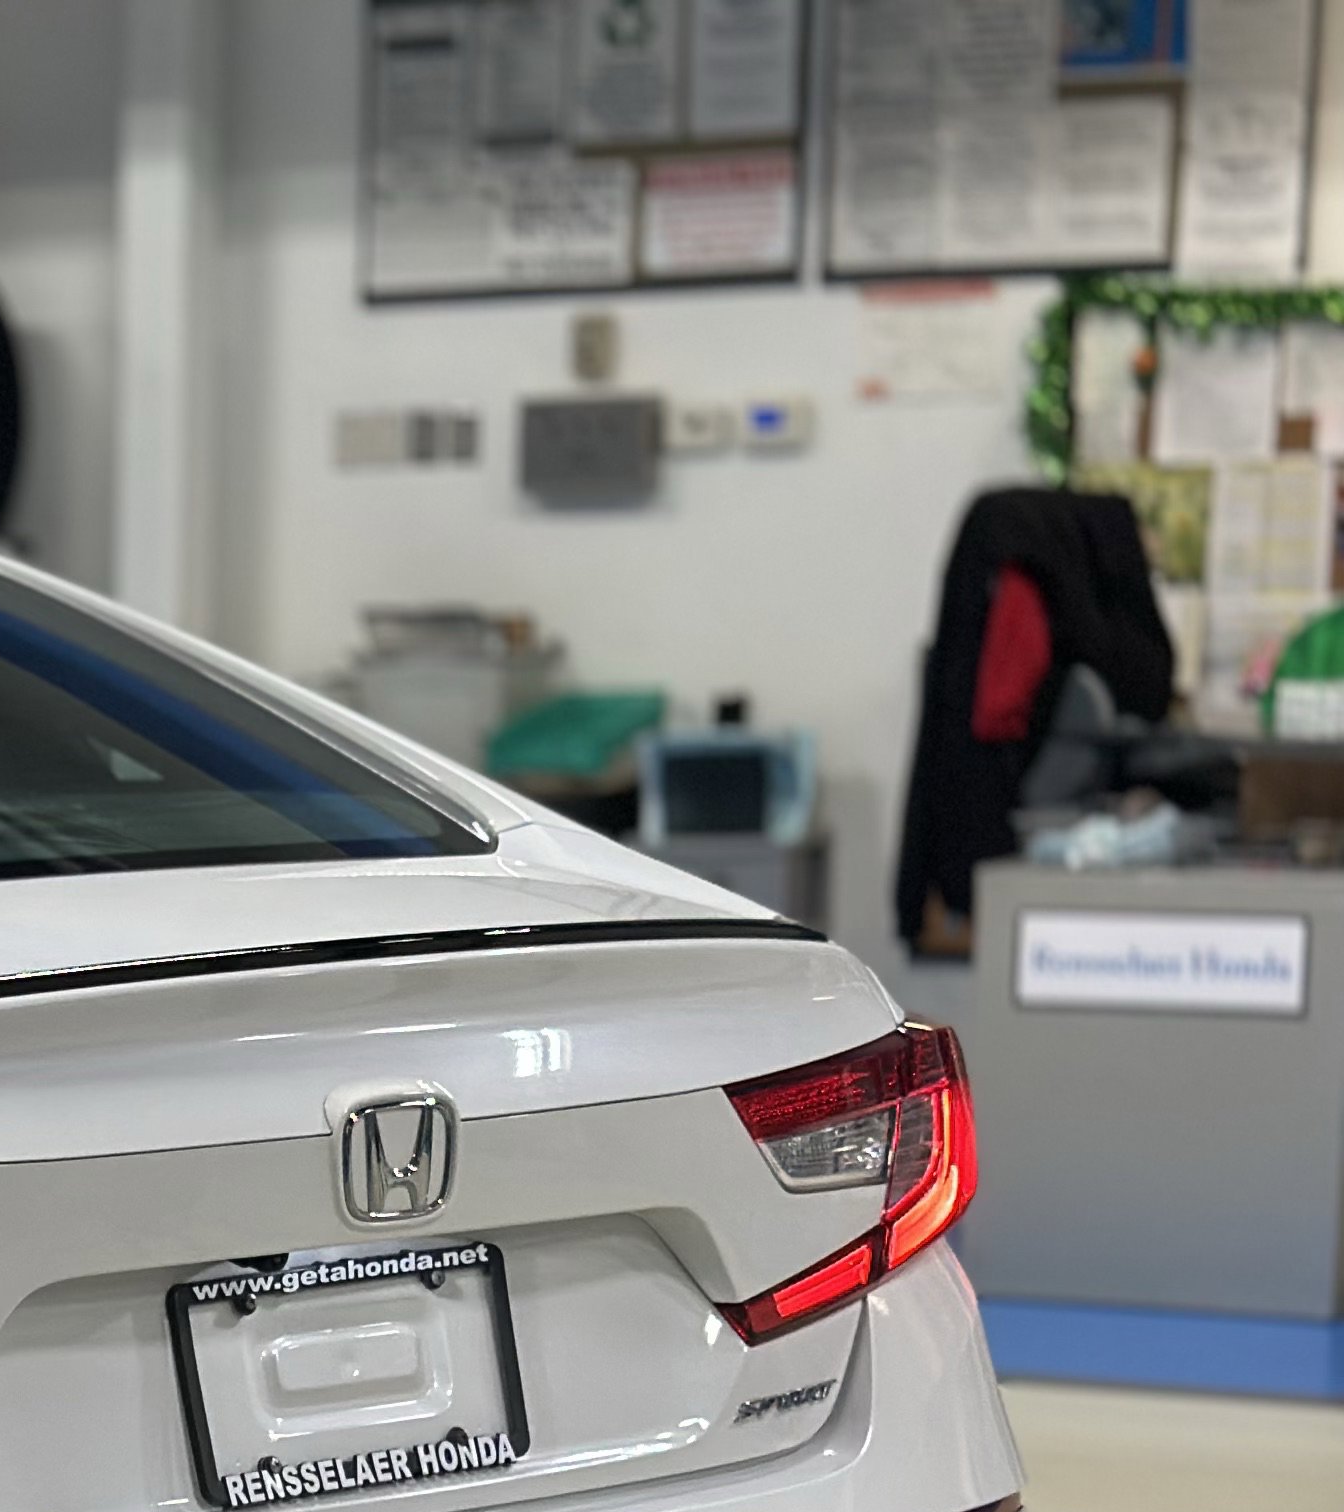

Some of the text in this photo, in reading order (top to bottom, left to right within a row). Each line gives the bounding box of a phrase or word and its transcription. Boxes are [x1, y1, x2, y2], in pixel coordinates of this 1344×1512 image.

[193, 1242, 489, 1301] www.getahonda.net
[225, 1433, 517, 1507] RENSSELAER HONDA
